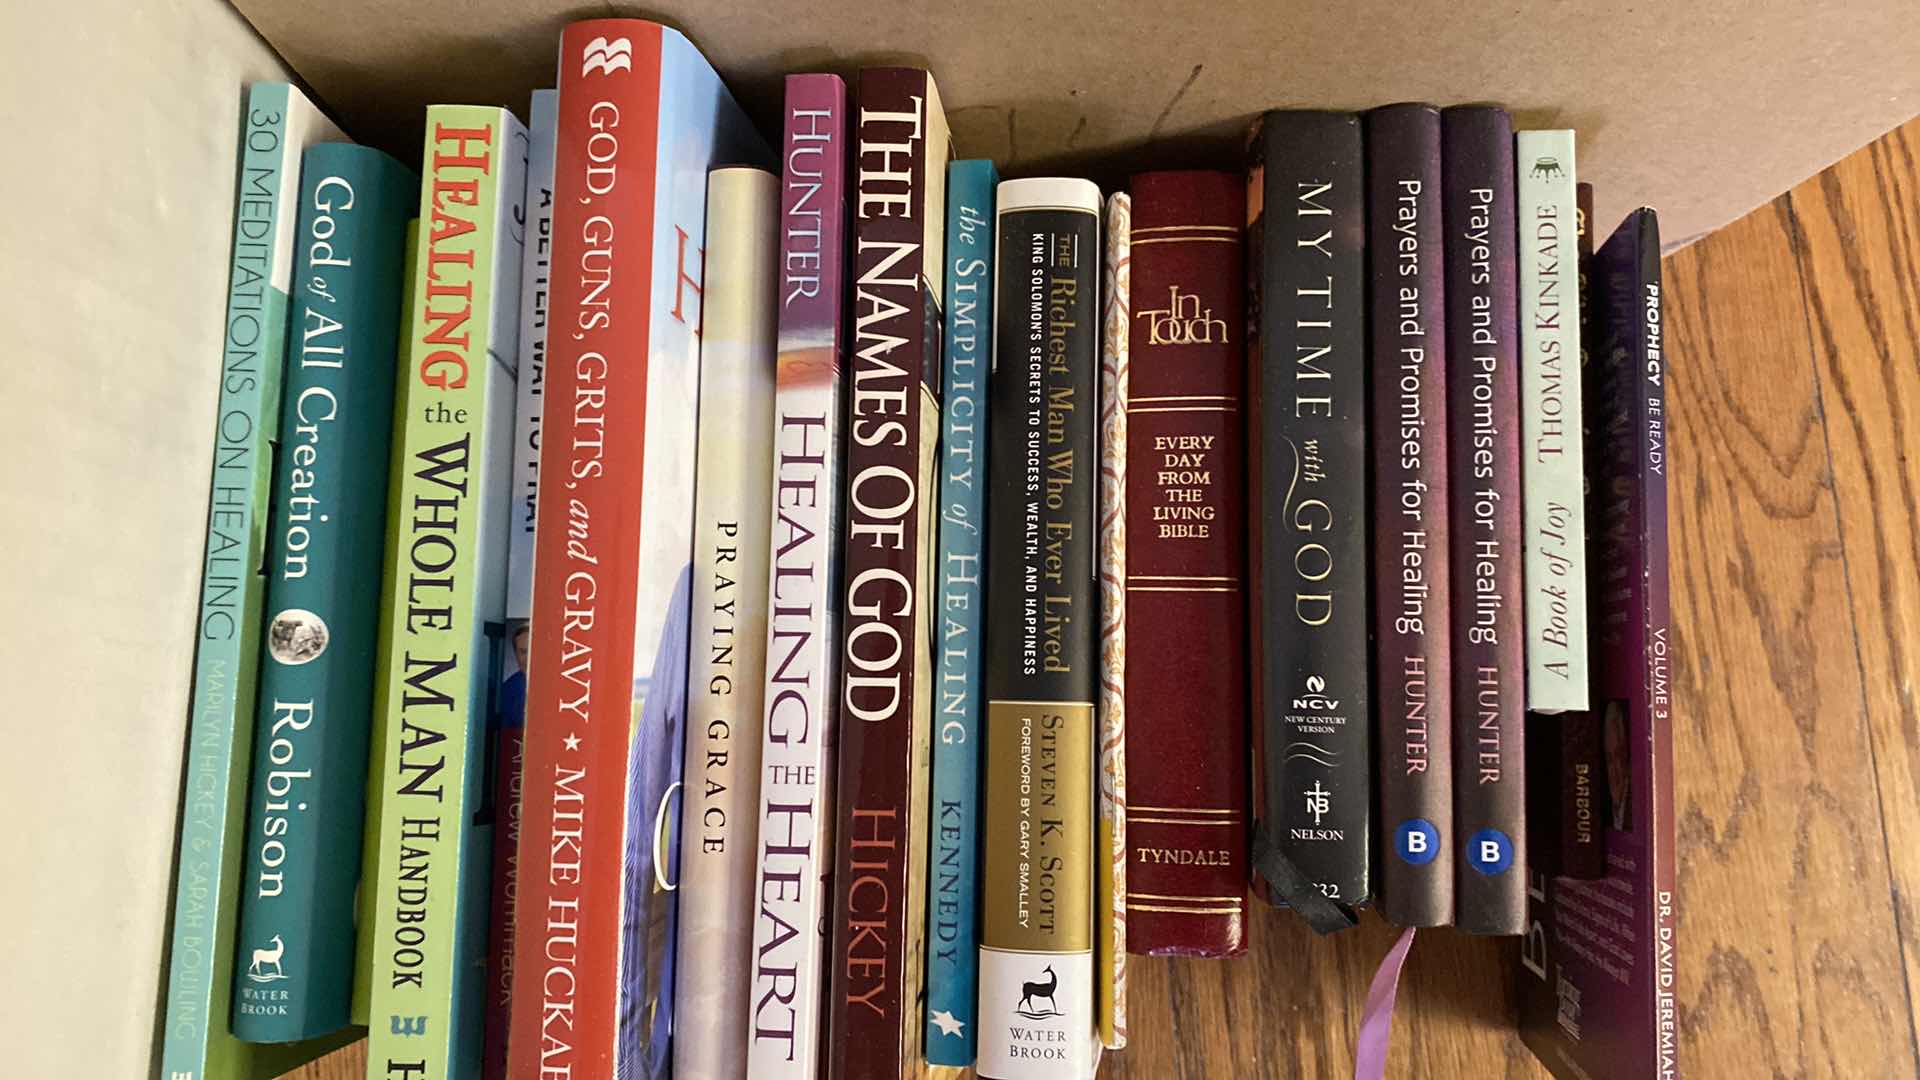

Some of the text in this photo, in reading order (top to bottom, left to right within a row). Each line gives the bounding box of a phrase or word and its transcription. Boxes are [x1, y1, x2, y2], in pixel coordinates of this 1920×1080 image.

[787, 106, 831, 309] HUNTER
[206, 108, 281, 642] 30 MEDITATIONS ON HEALING
[1136, 285, 1230, 345] In Touch
[1534, 204, 1563, 465] THOMAS KINKADE
[285, 175, 355, 583] God of All Creation
[560, 101, 618, 724] GOD, GUNS, GRITS, and GRAVY
[847, 95, 921, 723] THE NAMES OF GOD
[1294, 181, 1332, 627] MY TIME with GOD
[1392, 180, 1429, 636] Prayers and Promises for Healing
[1464, 188, 1503, 645] Prayers and Promises for Healing
[1646, 282, 1663, 475] PROPHECY BE READY
[942, 204, 986, 747] the SIMPLICITY of HEALING
[1023, 233, 1044, 676] KING SOLOMON'S SECRETS TO SUCCESS, WEALTH, AND HAPPINESS
[1043, 234, 1078, 674] THE Richest Man Who Ever Lived
[1153, 435, 1216, 450] EVERY
[1156, 471, 1212, 486] FROM
[1164, 453, 1206, 468] DAY
[1165, 488, 1203, 503] THE
[393, 121, 491, 990] HEALING the WHOLE MAN HANDBOOK
[1152, 506, 1216, 521] LIVING
[1157, 524, 1210, 539] BIBLE
[1540, 501, 1574, 681] A Book of Joy
[201, 659, 227, 748] MARILYN
[703, 521, 737, 855] PRAYING GRACE
[1284, 714, 1347, 726] NEW CENTURY
[1292, 700, 1341, 711] NCV
[1297, 725, 1336, 735] VERSION
[1404, 656, 1429, 776] HUNTER
[1477, 665, 1501, 785] HUNTER
[1653, 627, 1668, 720] VOLUME 3
[191, 755, 219, 830] HICKEY
[756, 411, 825, 1062] HEALING THE HEART
[260, 696, 312, 899] Robison
[551, 763, 585, 885] MIKE
[1018, 717, 1032, 929] FOREWORD BY GARY SMALLEY
[1039, 713, 1064, 935] STEVEN K. SCOTT
[1136, 847, 1232, 867] TYNDALE
[1290, 828, 1344, 841] NELSON
[1407, 831, 1428, 853] B
[1480, 840, 1501, 863] B
[1575, 763, 1592, 844] BARBOUR
[184, 860, 209, 928] SARAH
[848, 807, 895, 1018] HICKEY
[939, 798, 961, 969] KENNEDY
[174, 935, 204, 1041] BOWLING
[240, 1002, 289, 1016] BROOK
[242, 986, 290, 1002] WATER
[1009, 1026, 1067, 1043] WATER
[1658, 890, 1676, 1080] DR. DAVID JEREMIAH
[1009, 1043, 1067, 1061] BROOK
